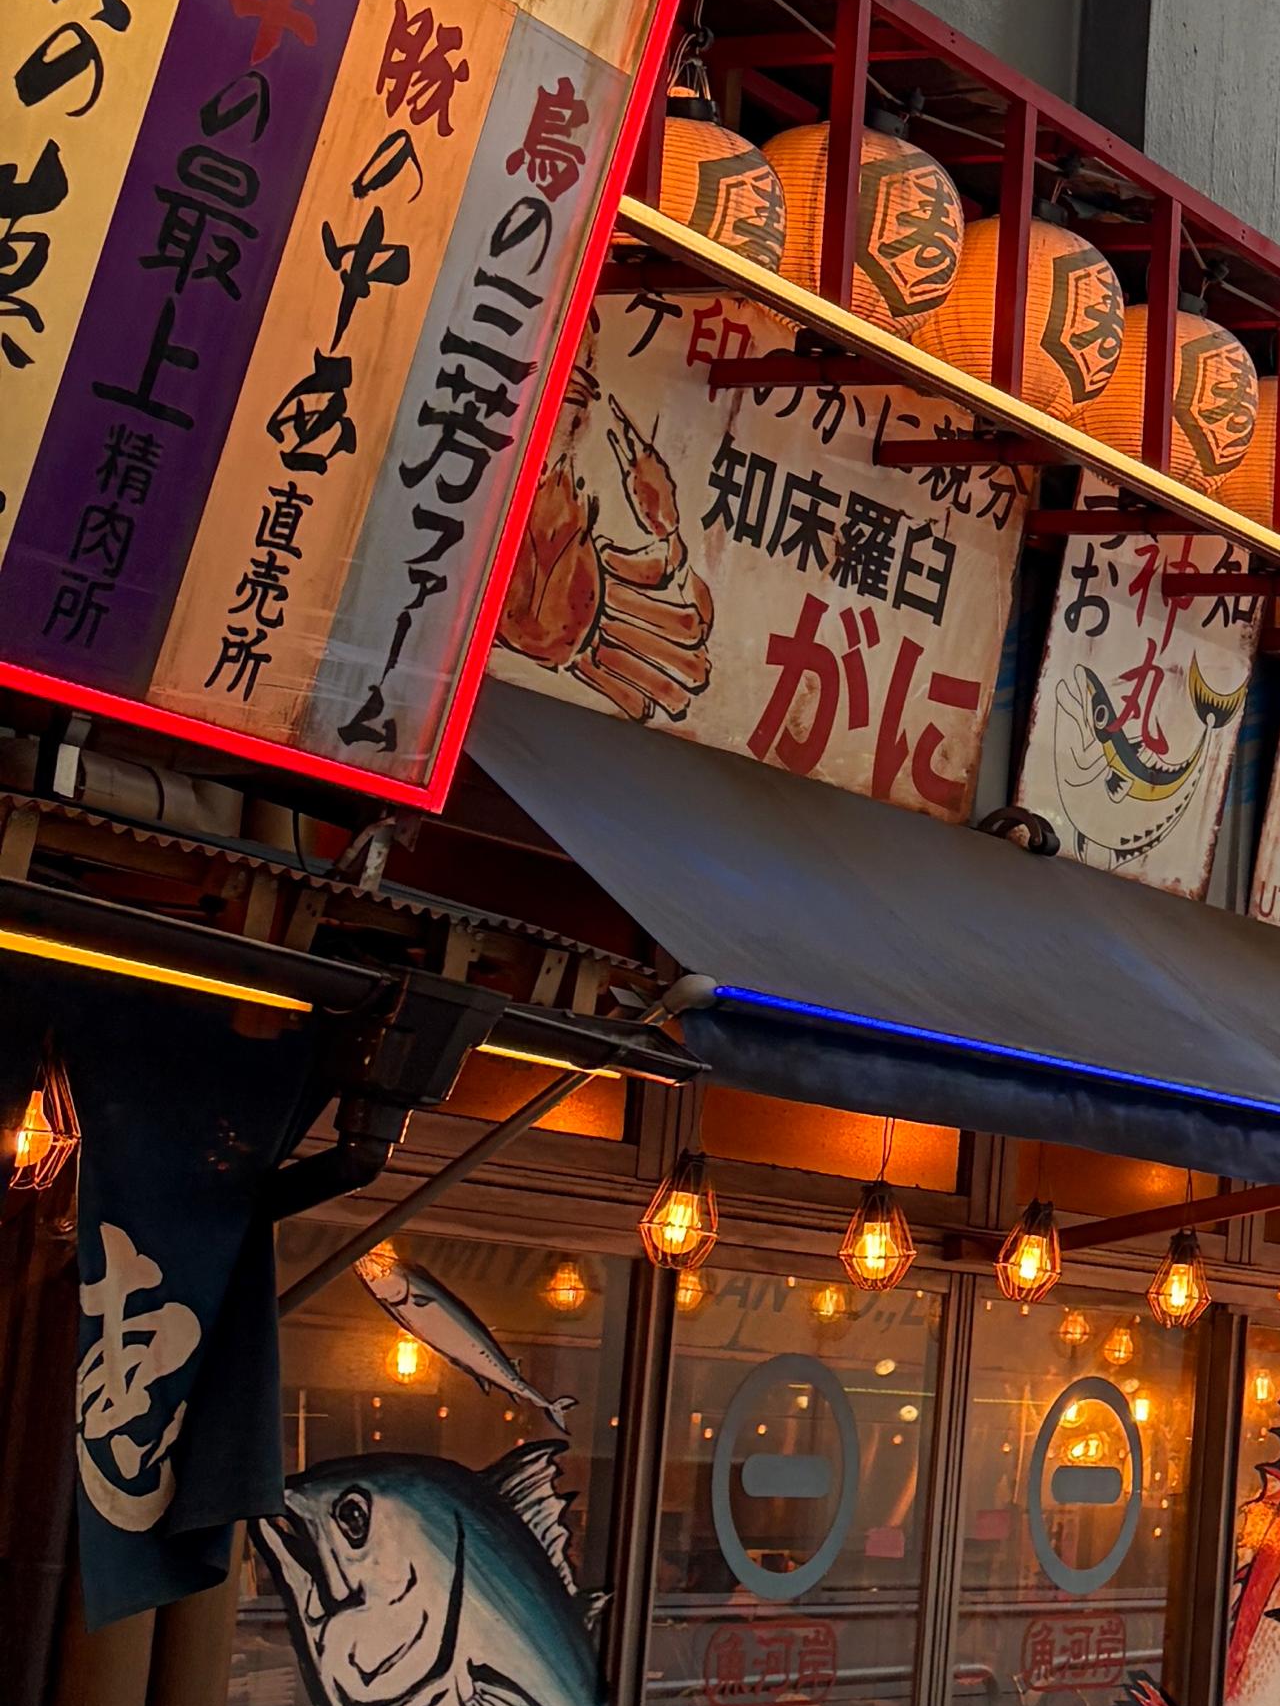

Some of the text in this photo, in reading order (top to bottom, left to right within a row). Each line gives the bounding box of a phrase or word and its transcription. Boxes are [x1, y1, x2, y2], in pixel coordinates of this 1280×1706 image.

[700, 433, 959, 627] 知床羅臼
[746, 592, 982, 810] がに
[711, 1628, 834, 1697] 魚河岸
[1023, 1619, 1126, 1684] 魚河岸
